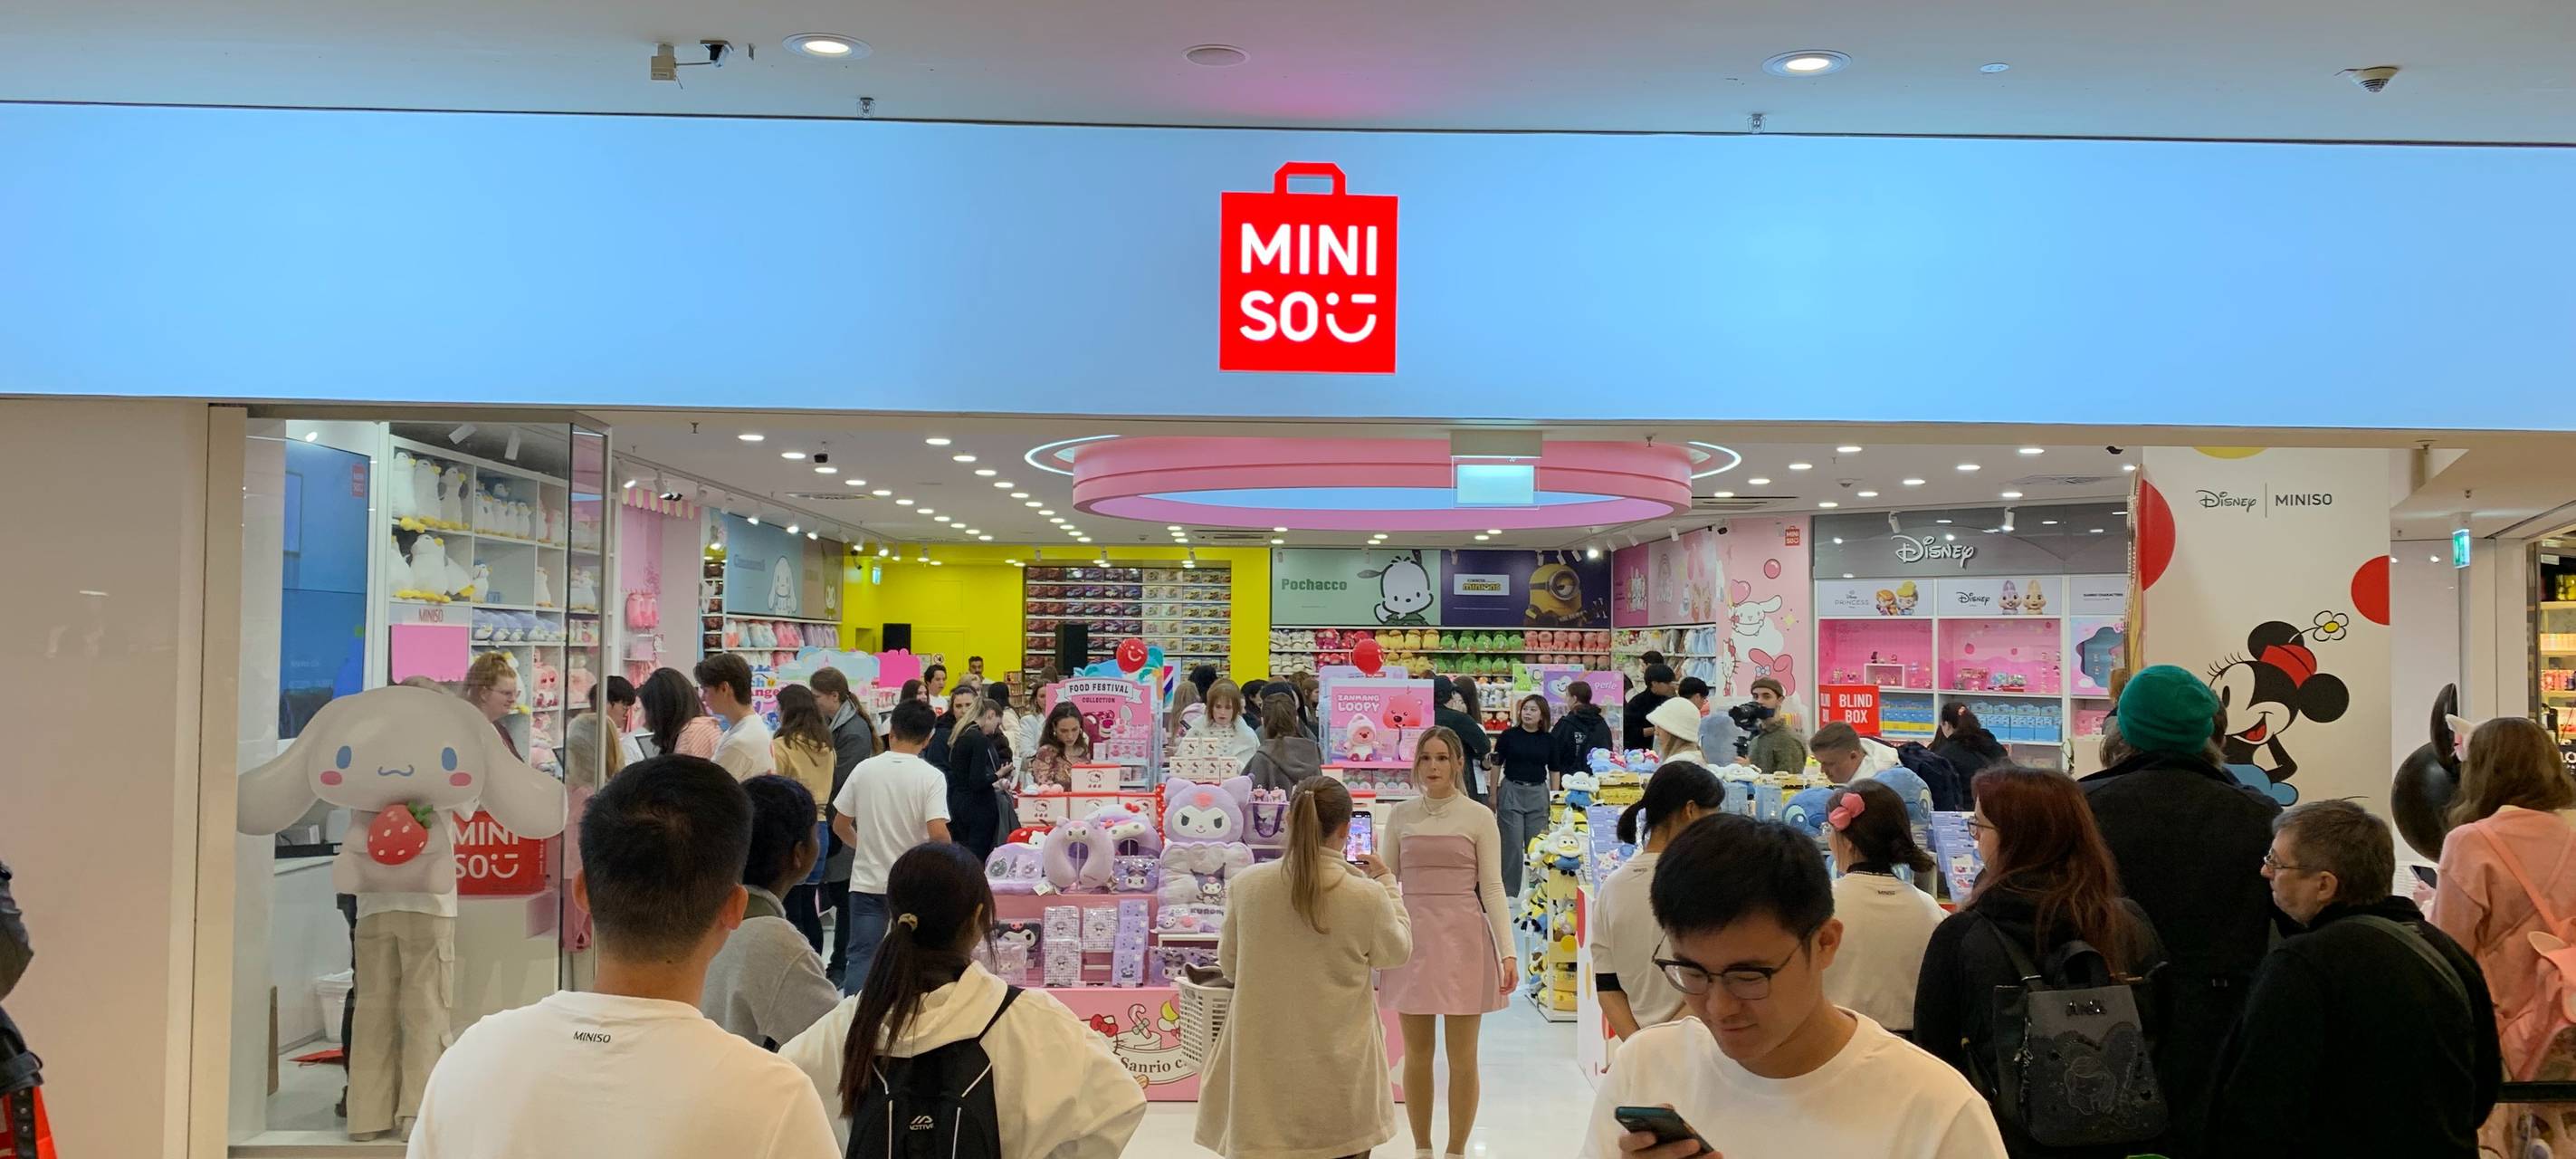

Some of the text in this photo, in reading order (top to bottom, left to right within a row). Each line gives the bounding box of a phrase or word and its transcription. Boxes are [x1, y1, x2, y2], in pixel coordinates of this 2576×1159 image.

[1241, 223, 1378, 276] MINI
[2195, 489, 2333, 512] Disney MINISO
[1890, 534, 1976, 569] Disney
[1281, 578, 1348, 591] Pochacco
[1956, 591, 1990, 606] Disney
[1069, 683, 1129, 694] FOOD FESTIVAL
[1338, 702, 1380, 713] LOOPY
[1839, 694, 1874, 708] BLIND
[1846, 709, 1869, 724] BOX
[573, 1030, 612, 1044] MINISO
[1121, 1056, 1171, 1074] Sanrio
